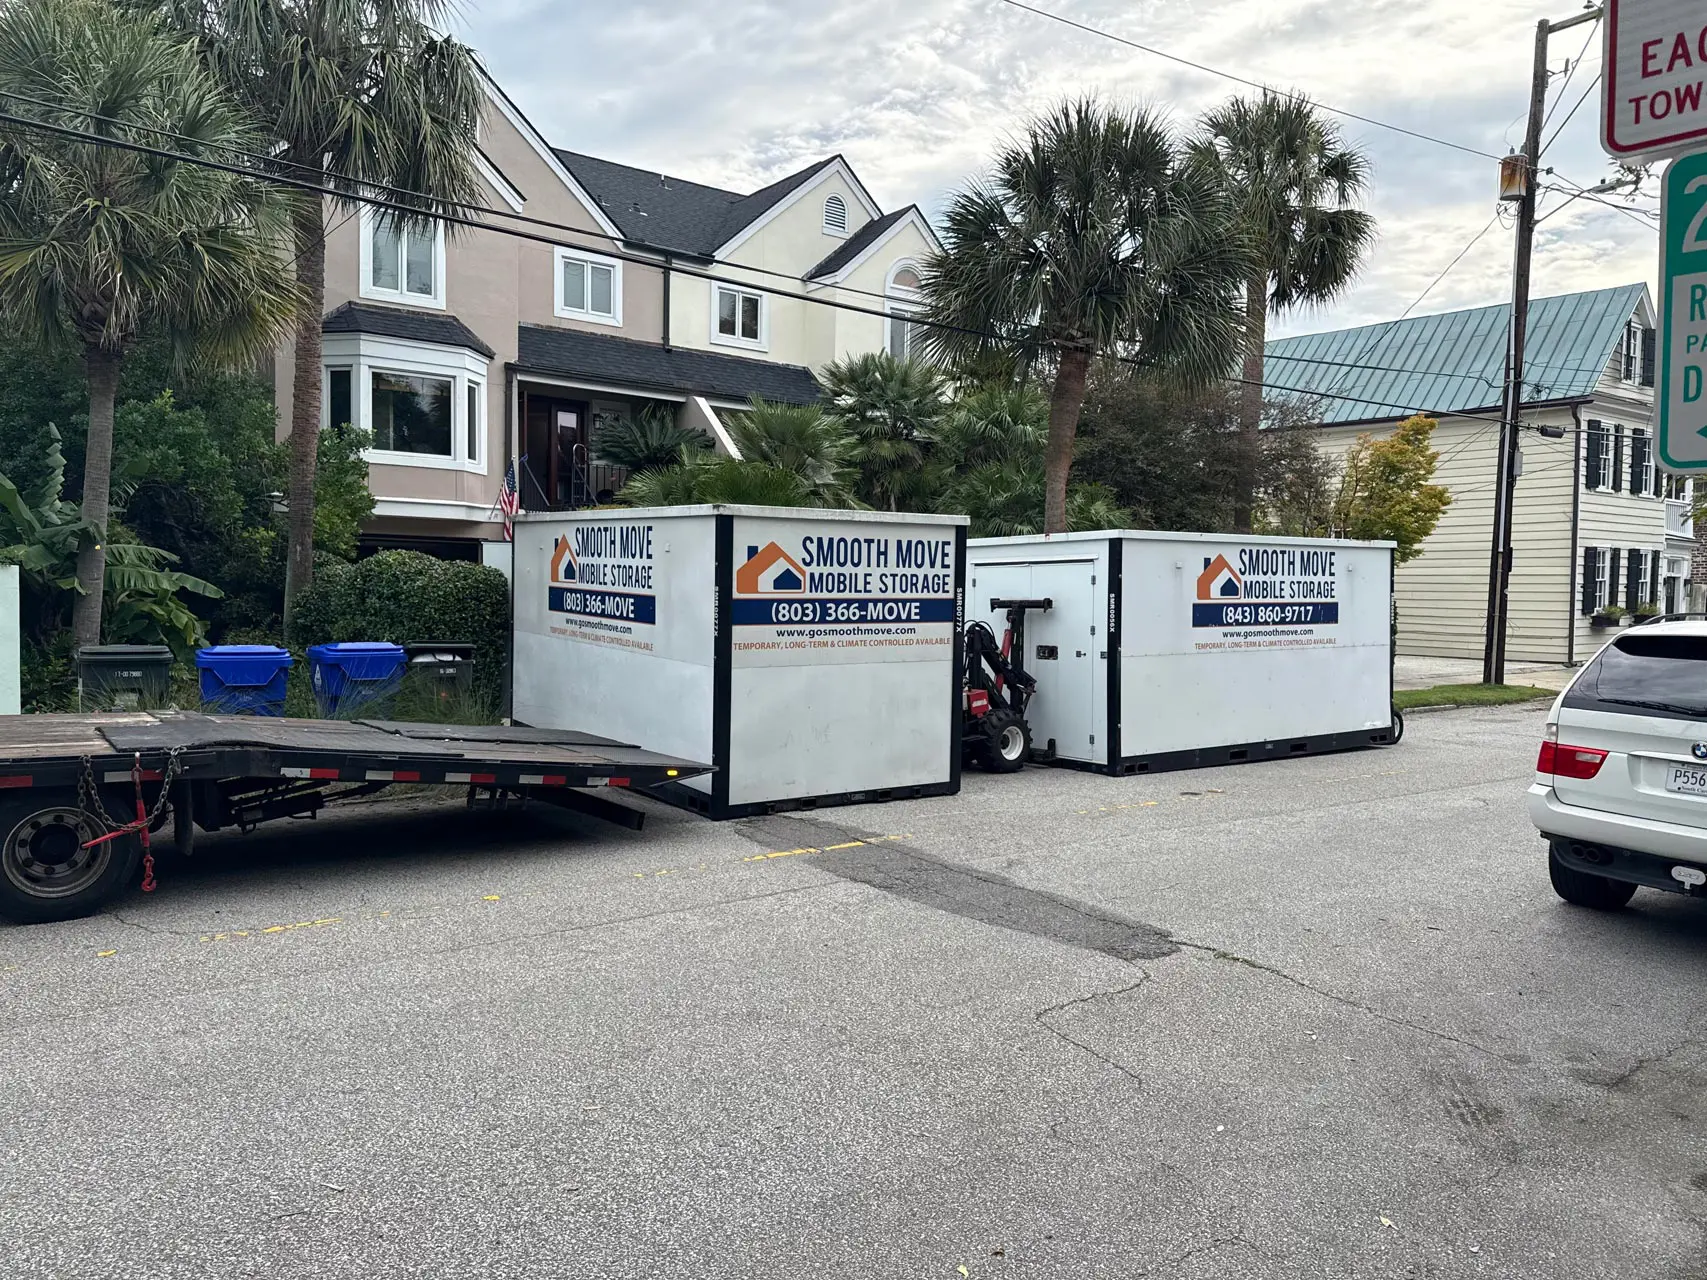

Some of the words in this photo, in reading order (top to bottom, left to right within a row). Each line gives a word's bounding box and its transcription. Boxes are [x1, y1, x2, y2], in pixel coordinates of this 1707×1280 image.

[1629, 81, 1707, 125] TOW
[575, 527, 616, 558] SMOOTH
[620, 526, 653, 560] MOVE
[801, 536, 888, 569] SMOOTH
[896, 539, 951, 569] MOVE
[1239, 548, 1295, 576] SMOOTH
[1300, 550, 1336, 577] MOVE
[579, 563, 607, 586] MOBILE
[611, 564, 653, 590] STORAGE
[809, 572, 873, 593] MOBILE
[879, 573, 951, 594] STORAGE
[1243, 580, 1285, 599] MOBILE
[1289, 581, 1336, 599] STORAGE
[563, 591, 584, 612] (803)
[586, 594, 635, 618] 366-MOVE
[771, 602, 821, 622] (803)
[826, 602, 921, 621] 366-MOVE
[1222, 605, 1255, 624] (843)
[1257, 605, 1313, 622] 860-9717
[565, 618, 632, 634] www.gosmoothmove.com
[776, 626, 916, 638] www.gosmoothmove.com
[1222, 628, 1314, 639] www.gosmoothmove.com
[733, 641, 783, 651] TEMPORARY,
[785, 640, 829, 649] LONG-TERM
[830, 640, 836, 648] &
[837, 639, 868, 648] CLIMATE
[868, 638, 914, 647] CONTROLLED
[915, 637, 951, 646] AVAILABLE
[1313, 637, 1337, 645] AVAILABLE
[1673, 769, 1706, 787] P556
